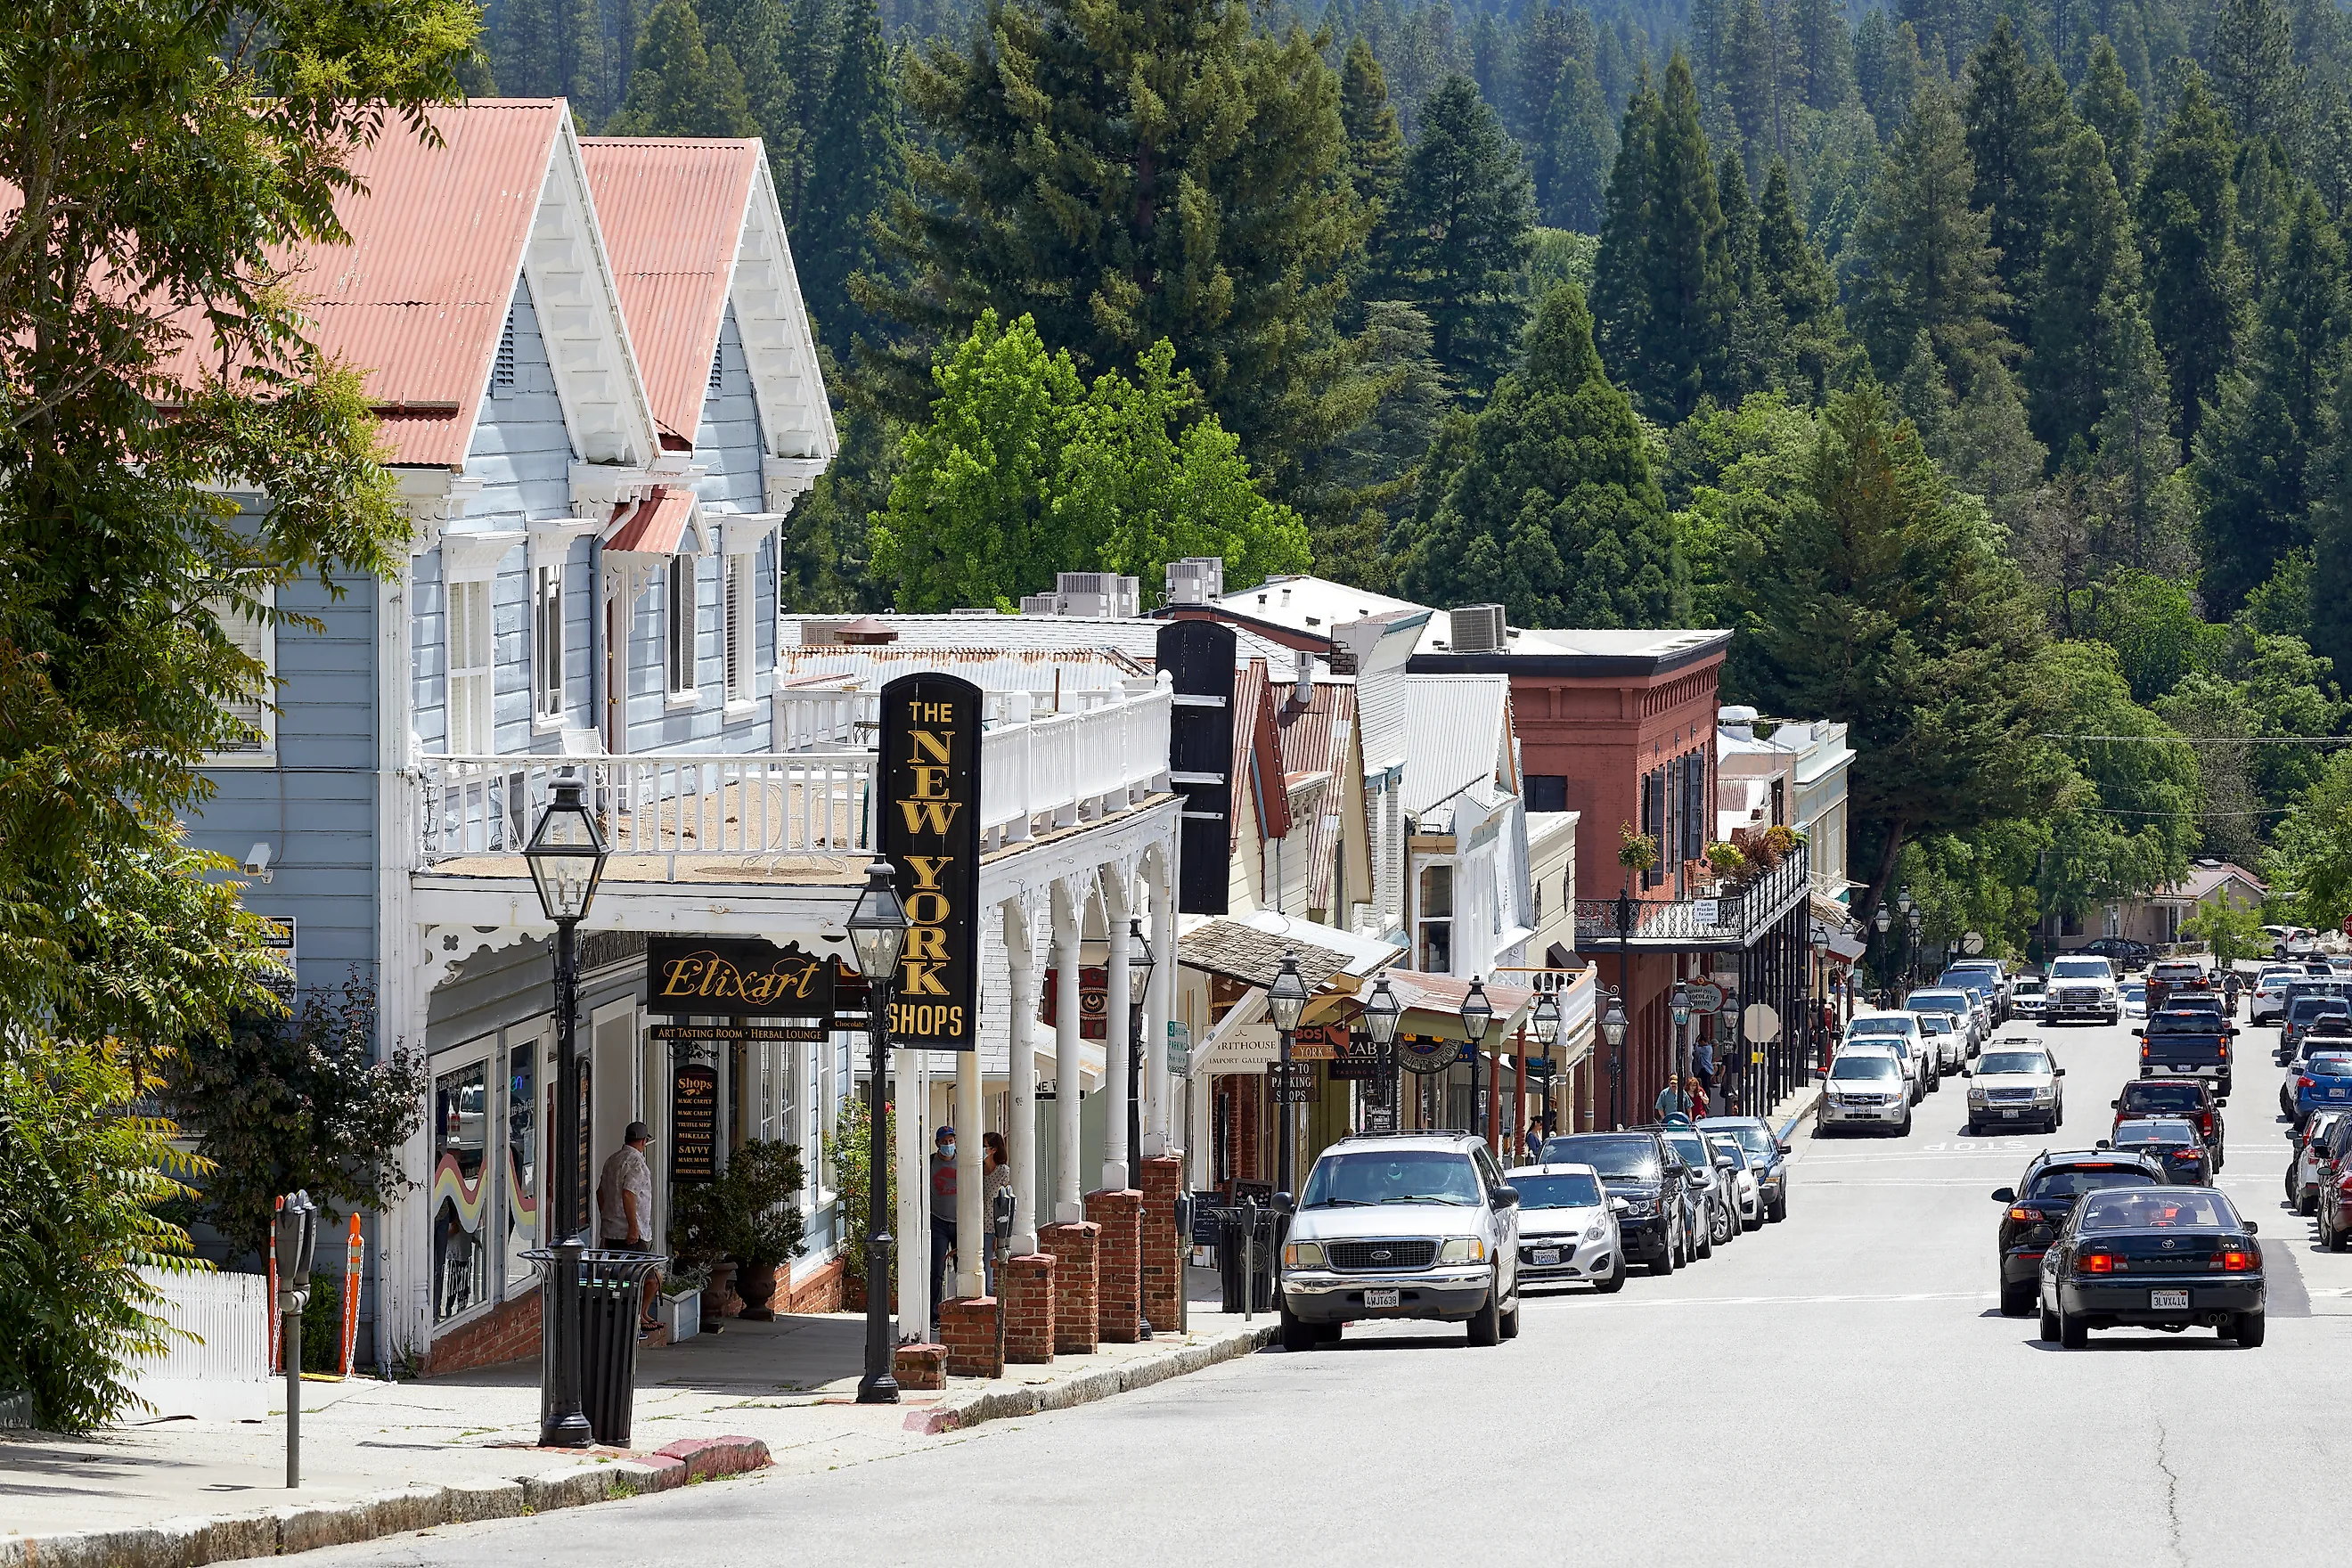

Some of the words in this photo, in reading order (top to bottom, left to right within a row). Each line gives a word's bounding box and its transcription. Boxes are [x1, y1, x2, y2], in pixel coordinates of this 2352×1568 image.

[909, 701, 952, 723] THE
[895, 730, 962, 835] NEW
[900, 855, 953, 996] YORK
[659, 950, 821, 1006] Elixart
[1689, 993, 1719, 1002] OCOLATE
[835, 1020, 864, 1028] Chocolate
[888, 1003, 963, 1036] SHOPS
[657, 1028, 675, 1038] ART
[677, 1028, 713, 1039] TASTING
[715, 1028, 743, 1039] ROOM
[751, 1029, 784, 1039] HERBAL
[786, 1029, 821, 1040] LOUNGE
[1169, 1024, 1174, 1034] 3
[1300, 1047, 1324, 1058] YORK
[1401, 1051, 1428, 1071] HAT
[1430, 1038, 1460, 1069] STOR
[1297, 1063, 1310, 1074] TO
[678, 1077, 713, 1091] Shops
[1035, 1081, 1049, 1092] NE
[1271, 1076, 1311, 1088] PAKING
[1276, 1090, 1306, 1102] SOPS
[678, 1146, 710, 1155] SAVVY
[2153, 1297, 2186, 1306] 3LVX414
